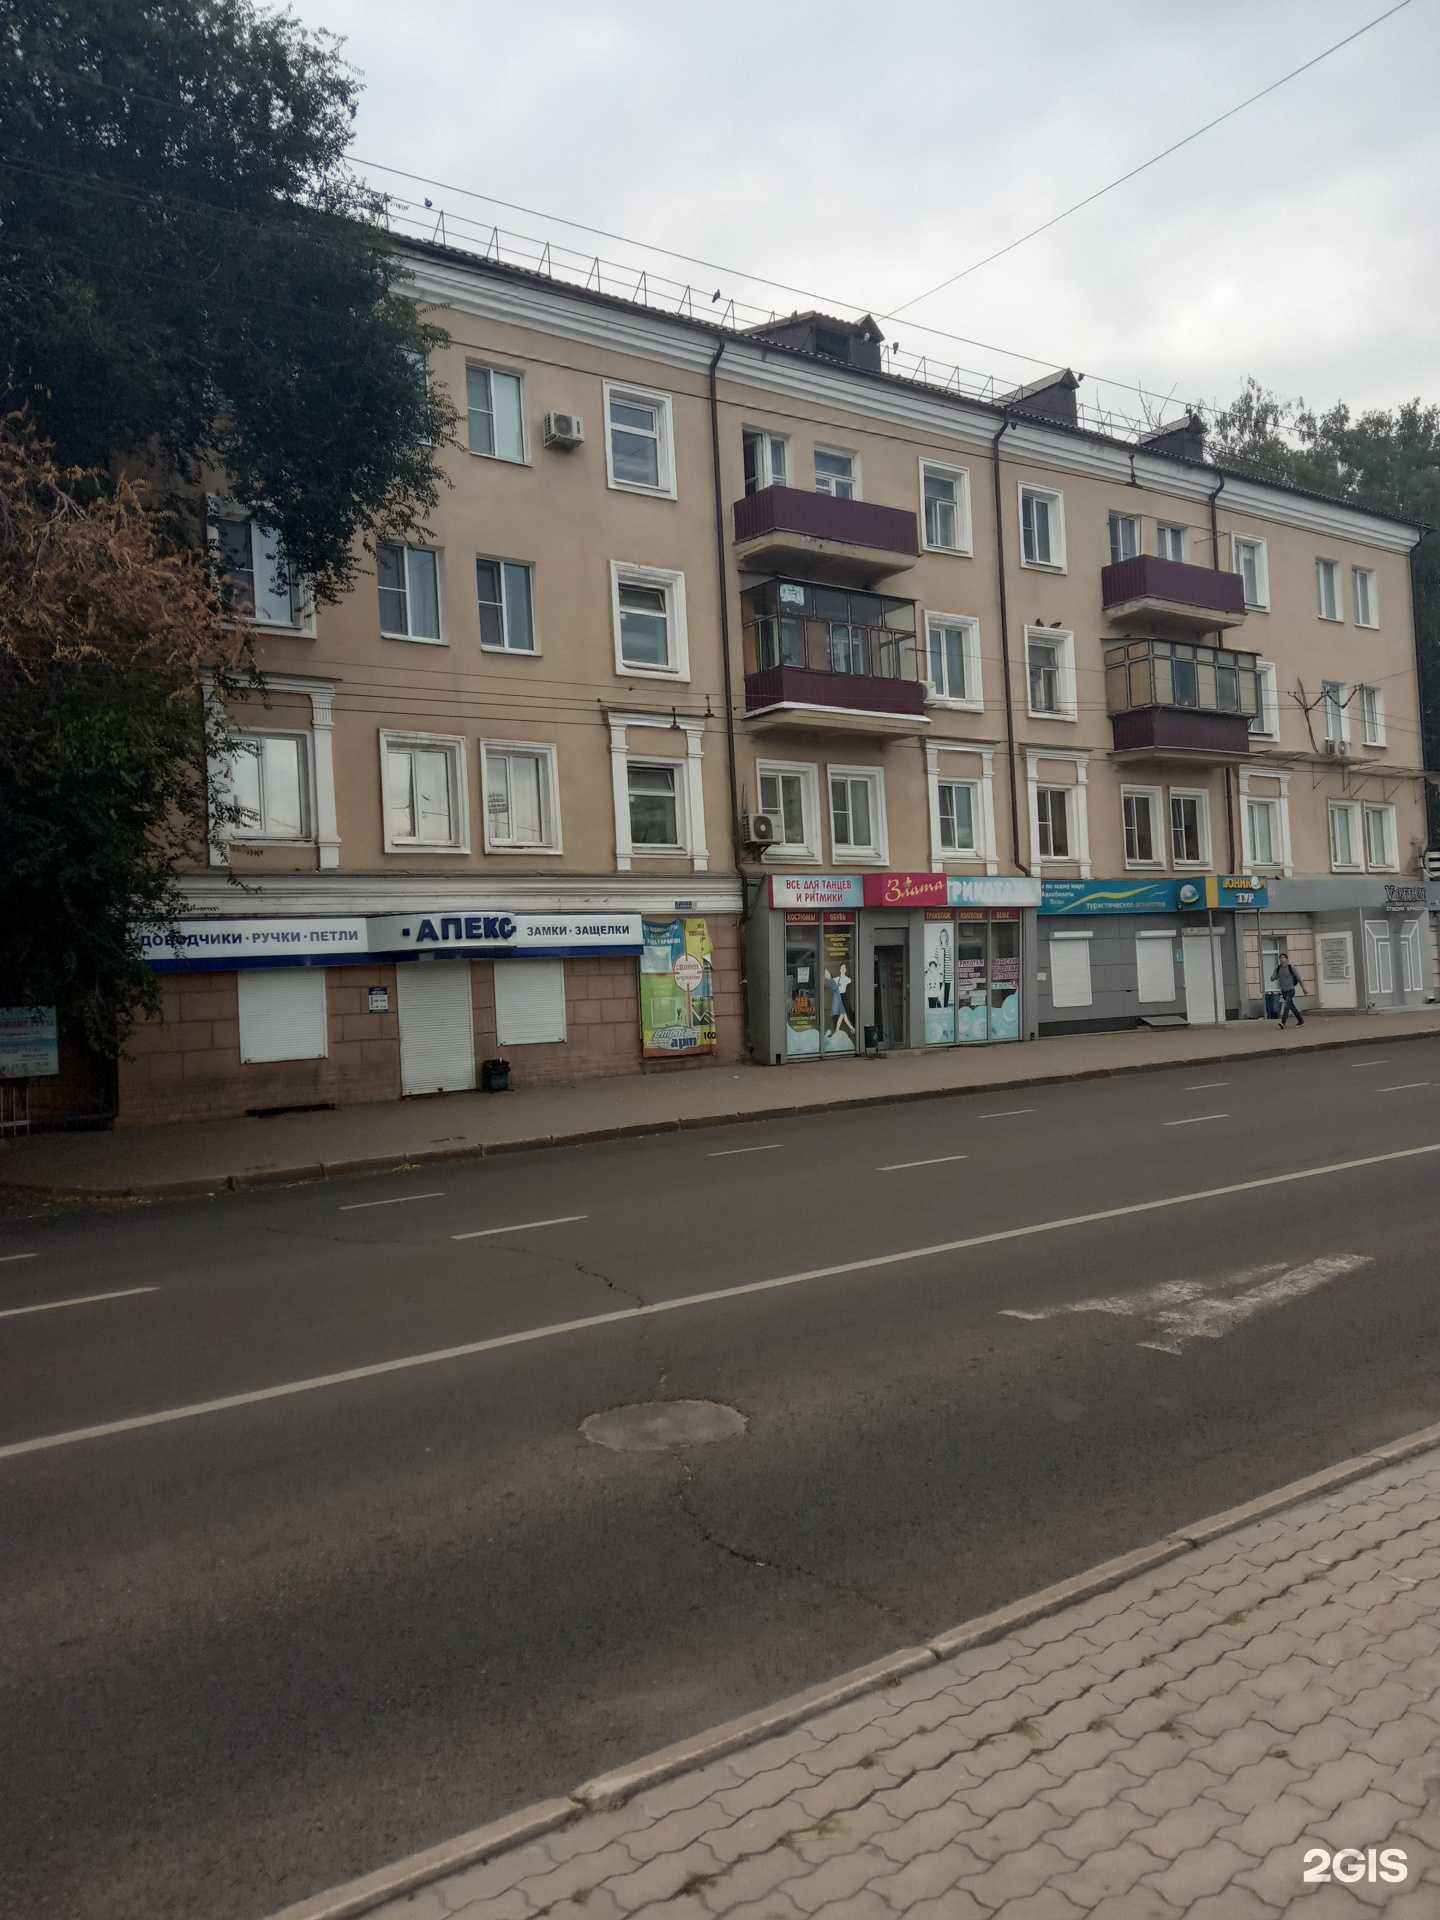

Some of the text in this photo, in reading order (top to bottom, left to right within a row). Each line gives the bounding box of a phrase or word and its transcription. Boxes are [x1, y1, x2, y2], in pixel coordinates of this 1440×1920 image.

[786, 880, 852, 891] ВСЕ ДЛЯ ТАНЦЕВ
[804, 892, 843, 902] РИТМИКИ
[416, 917, 517, 942] АПЕКС
[526, 926, 569, 937] ЗАМКИ
[574, 925, 630, 937] ЗАЩЕЛКИ
[252, 931, 301, 944] РУЧКИ
[309, 930, 359, 942] ПЕТЛИ
